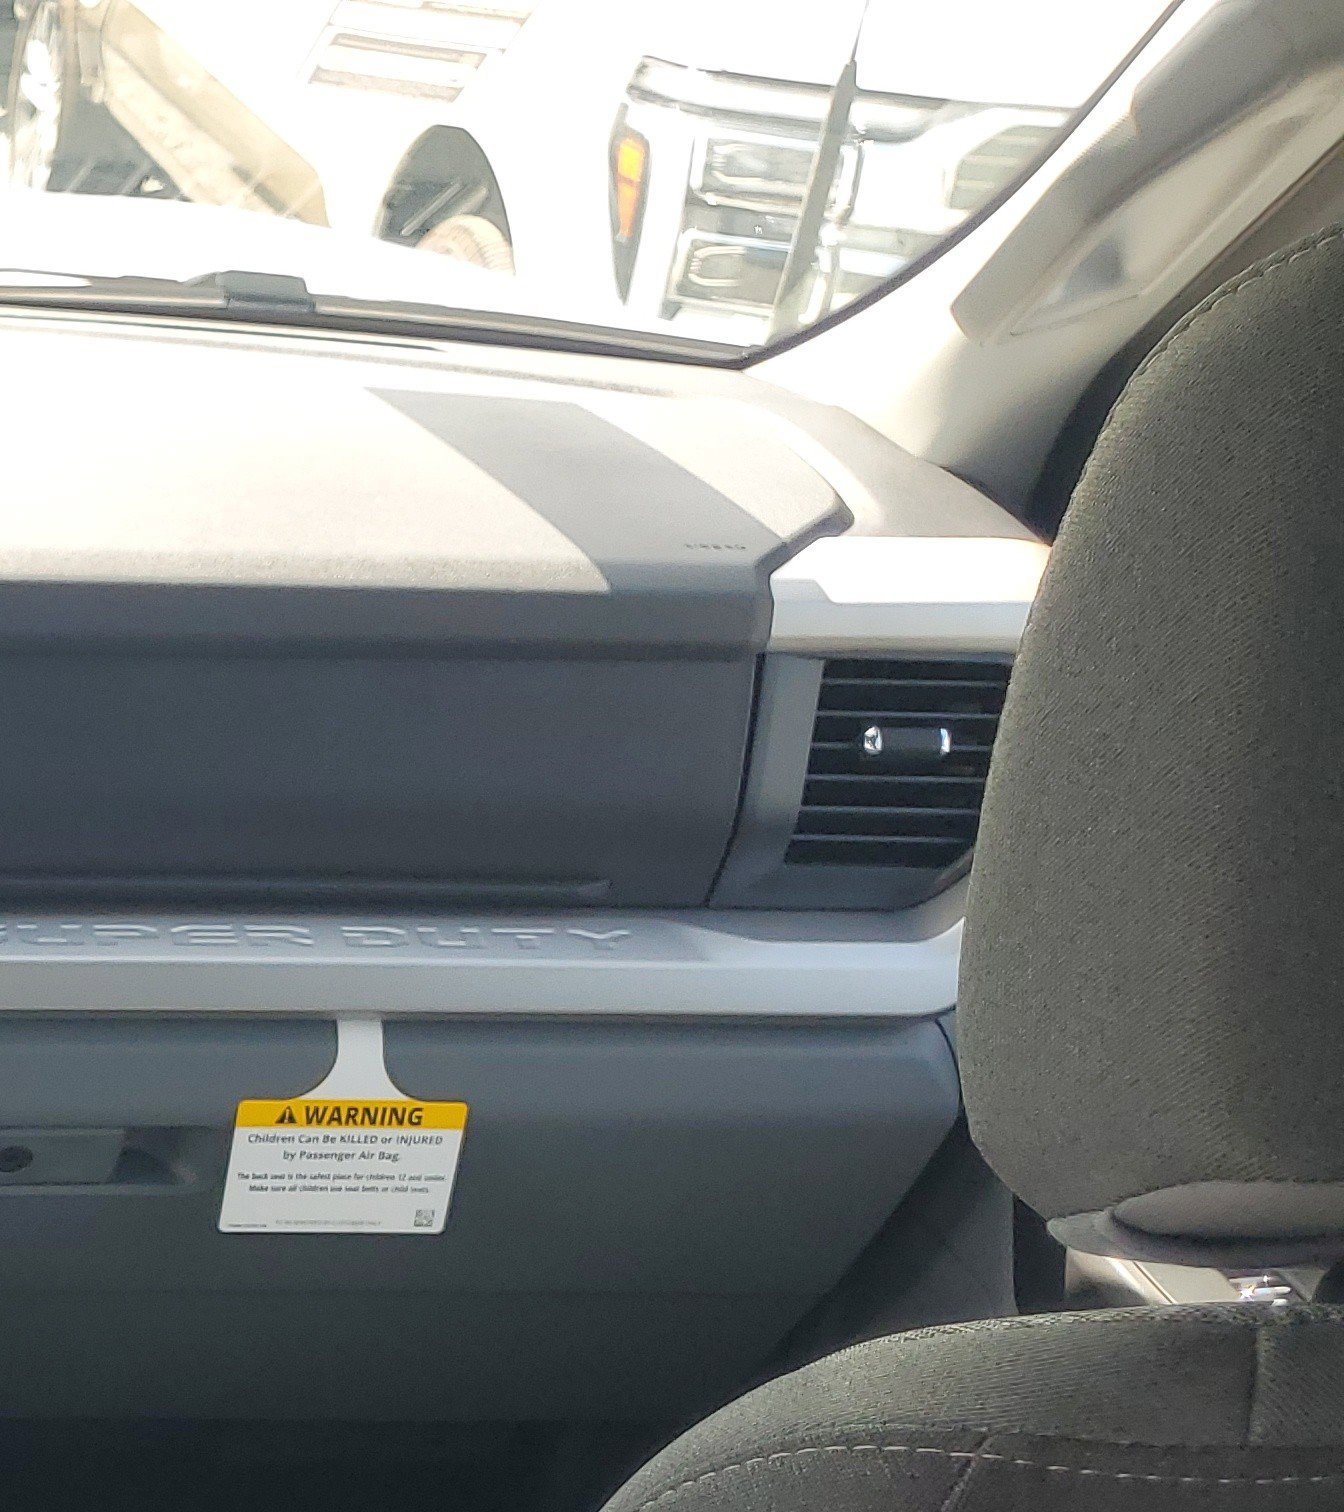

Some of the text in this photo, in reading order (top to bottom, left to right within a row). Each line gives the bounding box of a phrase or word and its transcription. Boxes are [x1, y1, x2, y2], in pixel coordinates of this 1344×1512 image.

[339, 924, 634, 950] DUTY
[304, 1105, 425, 1127] WARNING
[248, 1132, 444, 1147] Children Can Be KILLED or INJURED
[283, 1150, 297, 1162] by
[299, 1150, 356, 1162] Passenger
[358, 1151, 376, 1160] Air
